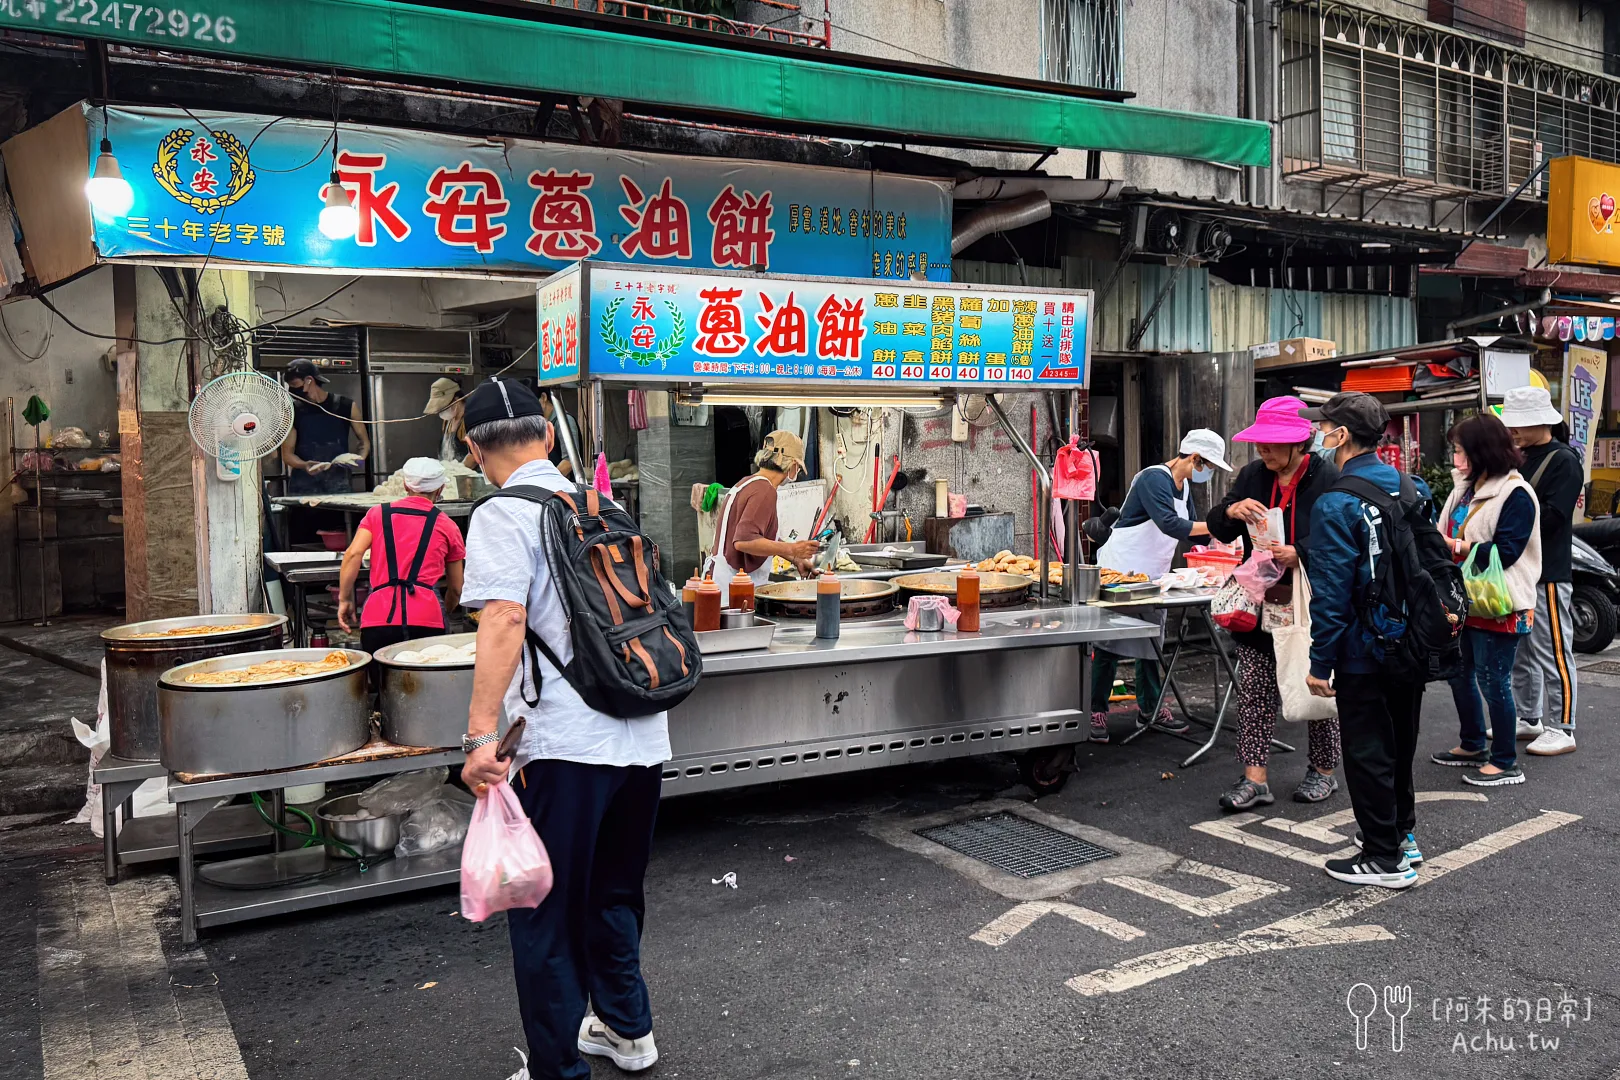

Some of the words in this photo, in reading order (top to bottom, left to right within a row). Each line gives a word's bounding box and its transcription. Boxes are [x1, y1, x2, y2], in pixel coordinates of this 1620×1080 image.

[189, 136, 219, 196] 永安
[127, 216, 286, 246] 三十年老字號
[319, 148, 776, 269] 永安蔥油餅
[614, 281, 678, 294] 三十年老字號
[541, 310, 577, 371] 蔥油餅
[630, 296, 656, 350] 永安
[692, 284, 868, 361] 蔥油餅
[872, 293, 899, 363] 蔥油餅
[901, 295, 927, 363] 韭菜盒
[929, 296, 955, 365] 黑豬肉餡餅
[957, 297, 983, 365] 蘿蔔絲餅
[985, 298, 1009, 366] 加蛋
[1041, 302, 1055, 359] 買十送一
[1059, 302, 1075, 365] 請由此排隊
[873, 365, 894, 378] 40
[902, 366, 923, 378] 40
[930, 366, 951, 379] 40
[958, 367, 978, 379] 40
[987, 368, 1003, 379] 10
[1010, 368, 1032, 379] 140
